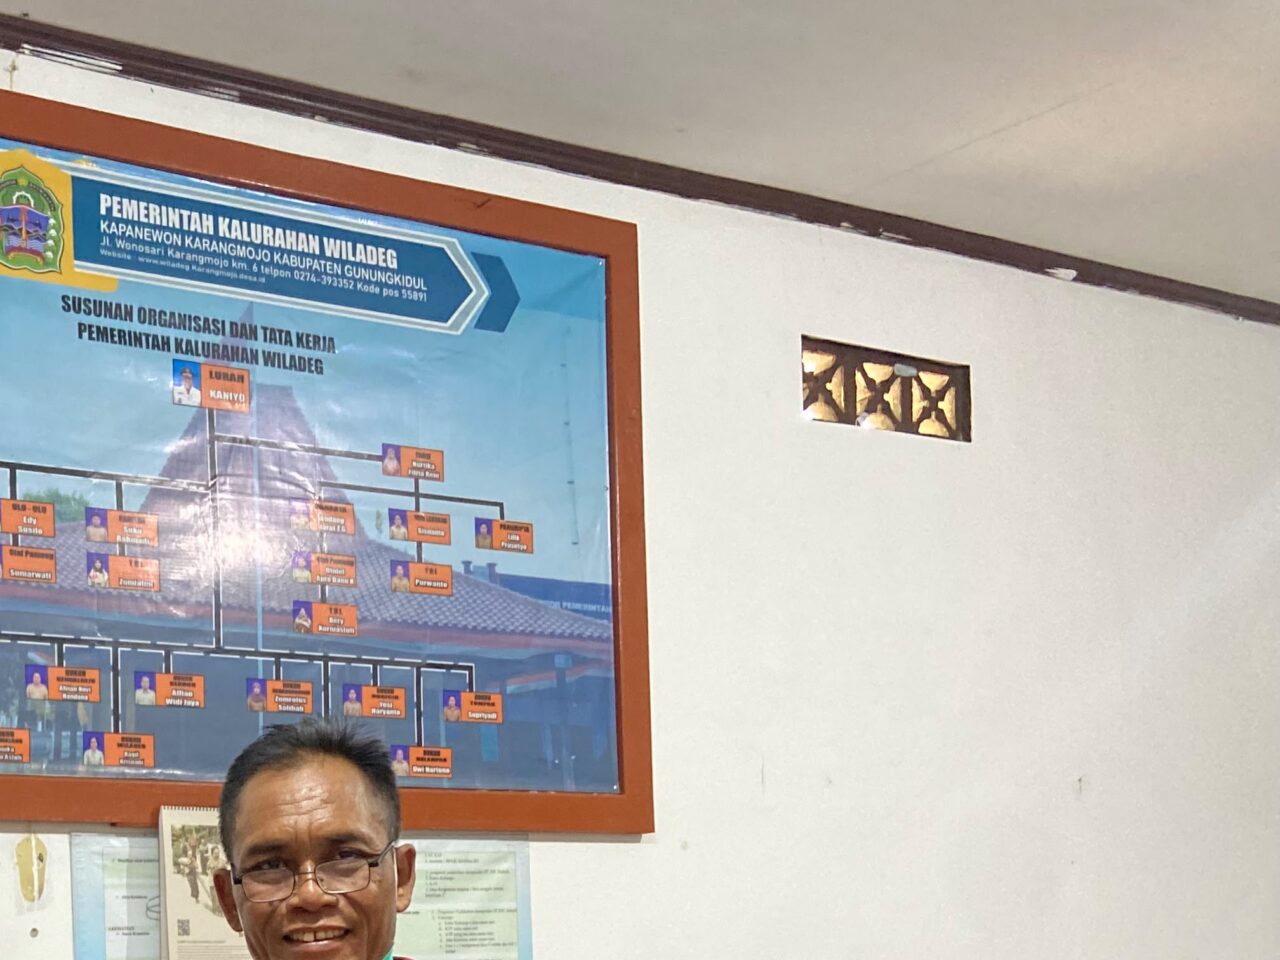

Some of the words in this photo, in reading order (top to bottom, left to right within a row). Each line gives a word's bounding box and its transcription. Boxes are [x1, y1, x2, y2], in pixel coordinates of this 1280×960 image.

[99, 193, 215, 235] PEMERINTAH
[218, 217, 320, 255] KALURAHAN
[323, 237, 398, 269] WILADEG
[100, 220, 182, 246] KAPANEWON
[185, 236, 270, 263] KARANGMOJO
[273, 252, 342, 275] KABUPATEN
[344, 265, 427, 290] GUNUNGKIDUL
[115, 238, 165, 256] Wonosari
[167, 248, 229, 268] Karangmojo
[252, 262, 258, 272] 6
[260, 264, 291, 279] telpon
[293, 269, 354, 290] 0274-393352
[356, 282, 380, 294] Kode
[382, 287, 399, 297] pos
[401, 290, 427, 302] 55891
[61, 294, 133, 322] SUSUNAN
[137, 306, 226, 336] ORGANISASI
[229, 320, 258, 341] DAN
[260, 325, 292, 347] TATA
[296, 331, 336, 354] KERJA
[77, 322, 171, 352] PEMERINTAH
[174, 337, 259, 365] KALURAHAN
[262, 350, 324, 375] WILADEG
[208, 369, 245, 383] LURAH
[209, 388, 246, 402] KANIYO
